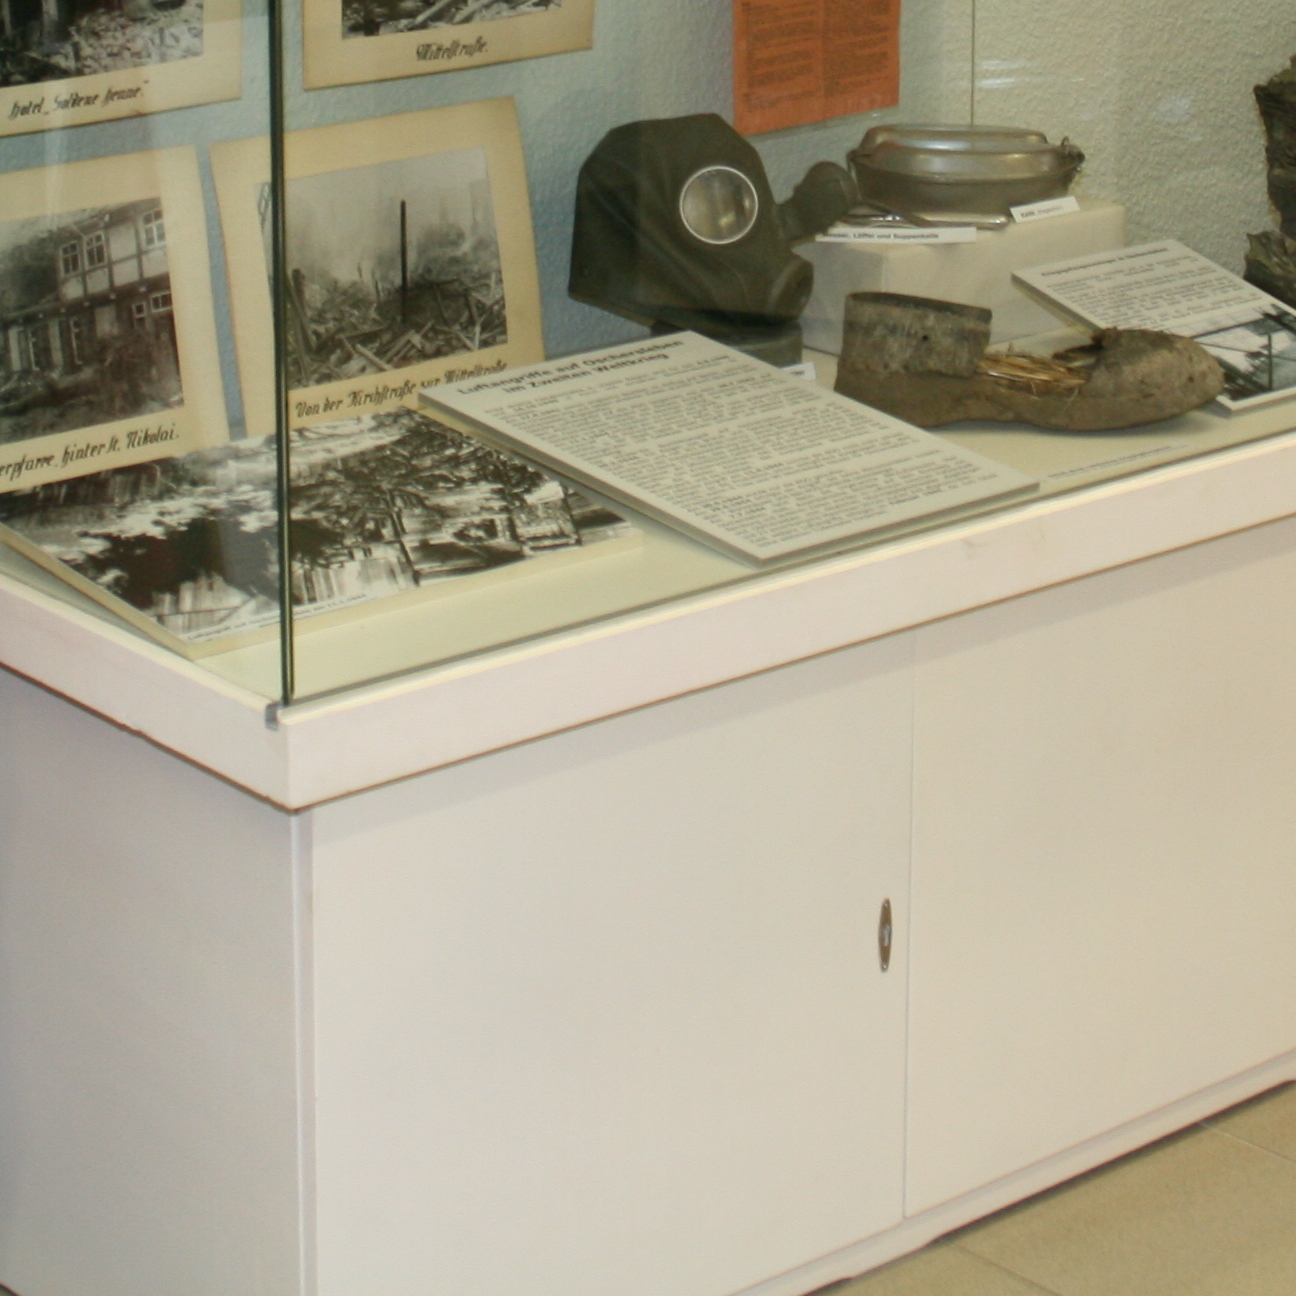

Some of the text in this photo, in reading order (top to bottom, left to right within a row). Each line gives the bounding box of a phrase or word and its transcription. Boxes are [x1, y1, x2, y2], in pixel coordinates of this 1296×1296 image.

[457, 340, 684, 396] Luftangriffe auf Oschersleben
[530, 372, 592, 389] Zweiten
[595, 353, 670, 374] Weltkrieg
[295, 401, 320, 418] Von
[323, 396, 344, 412] der
